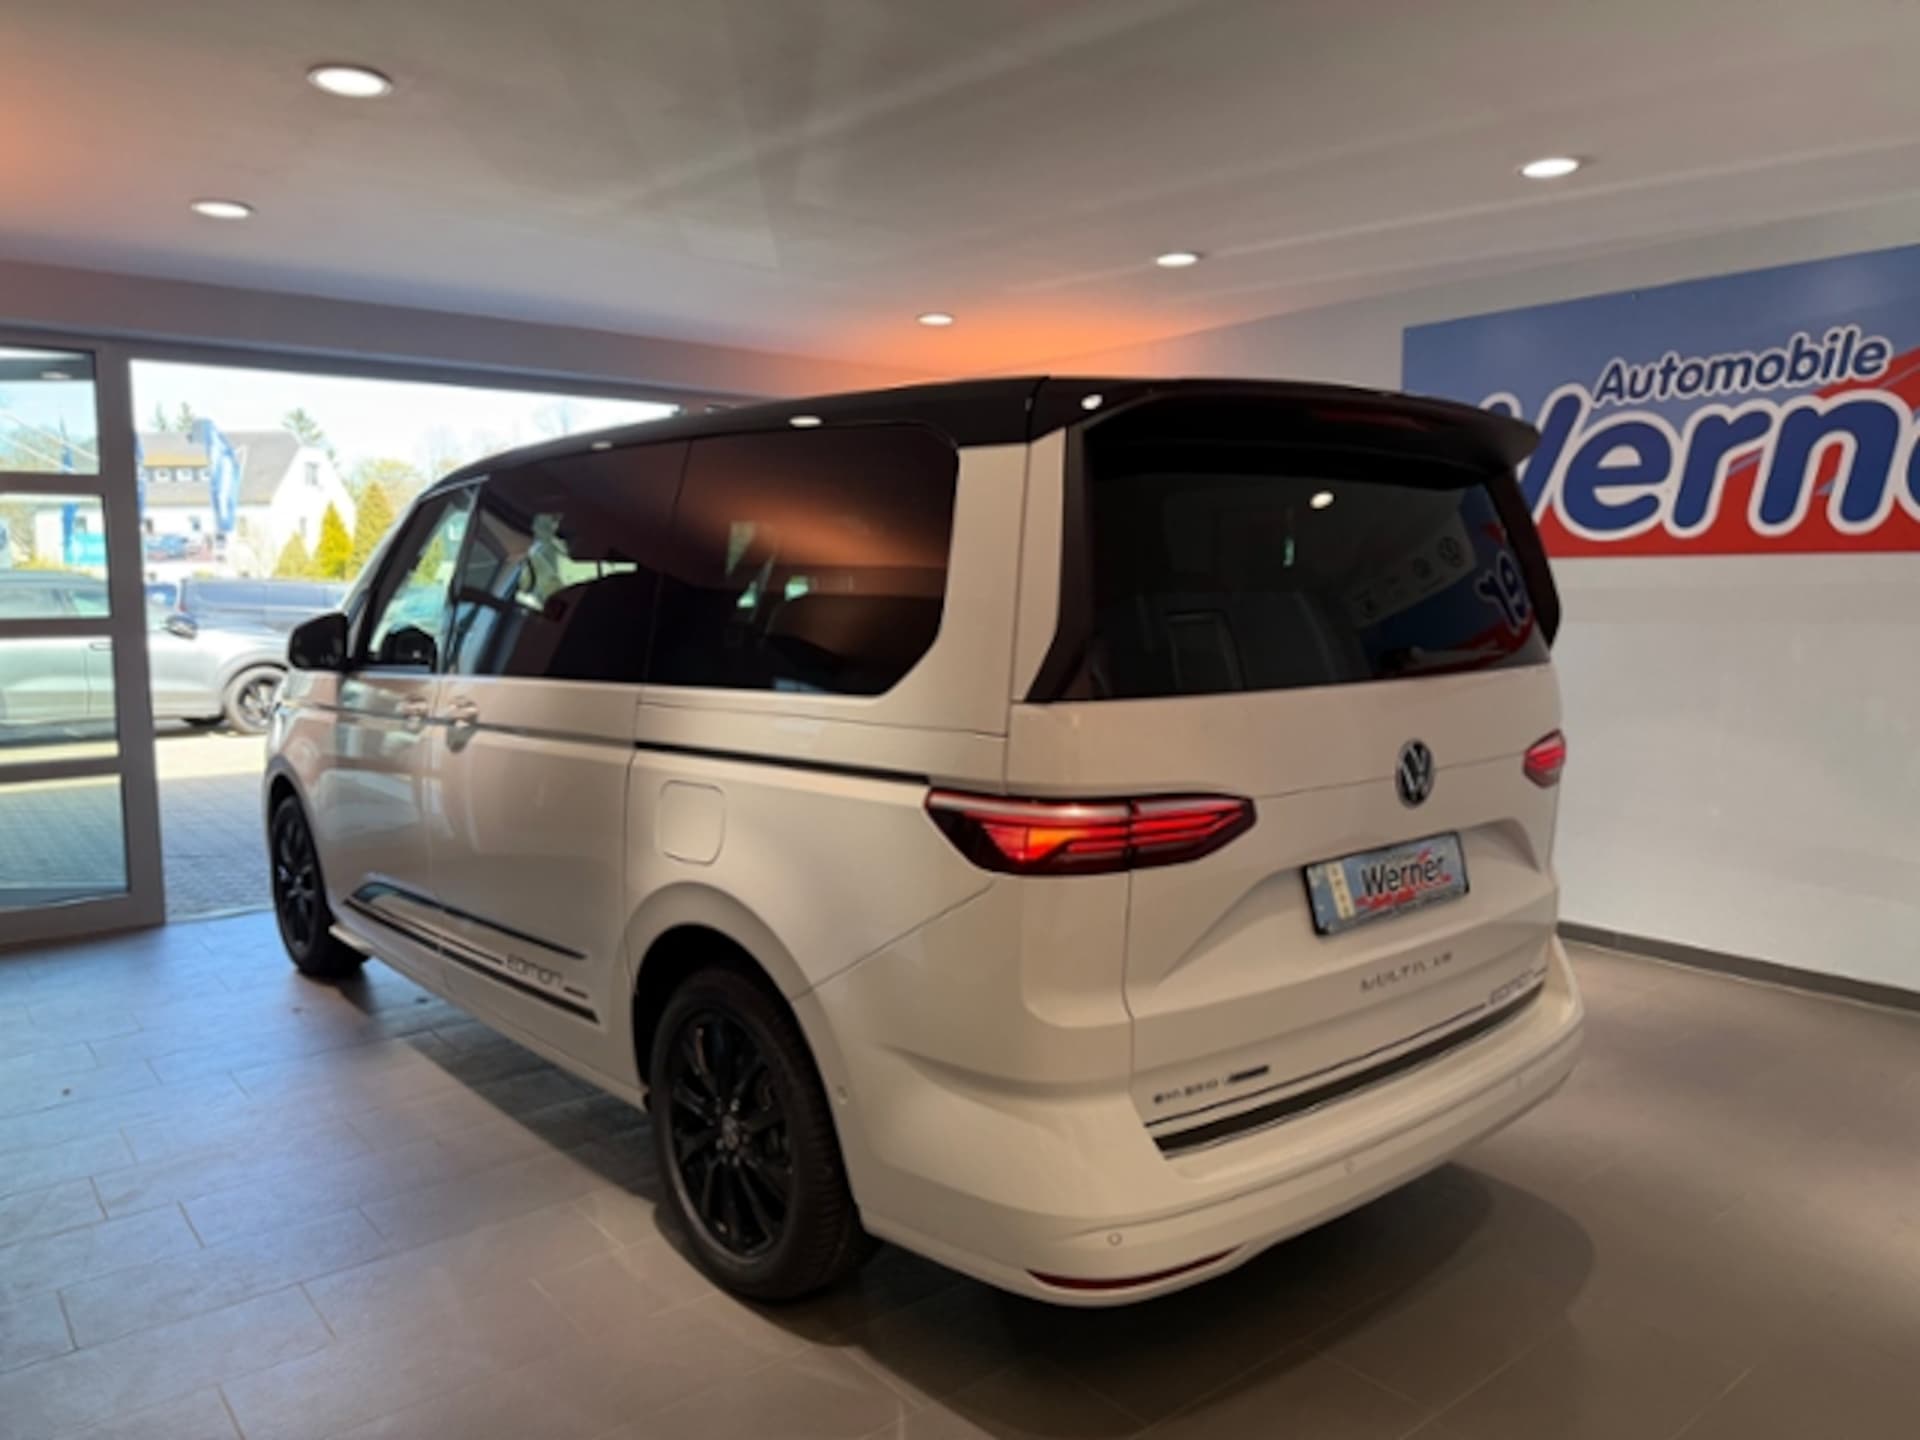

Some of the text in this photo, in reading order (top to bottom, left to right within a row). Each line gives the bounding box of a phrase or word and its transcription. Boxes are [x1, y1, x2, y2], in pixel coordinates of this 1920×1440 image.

[1594, 326, 1892, 404] Automobile
[1481, 384, 1919, 541] ern
[1361, 855, 1445, 897] Werner
